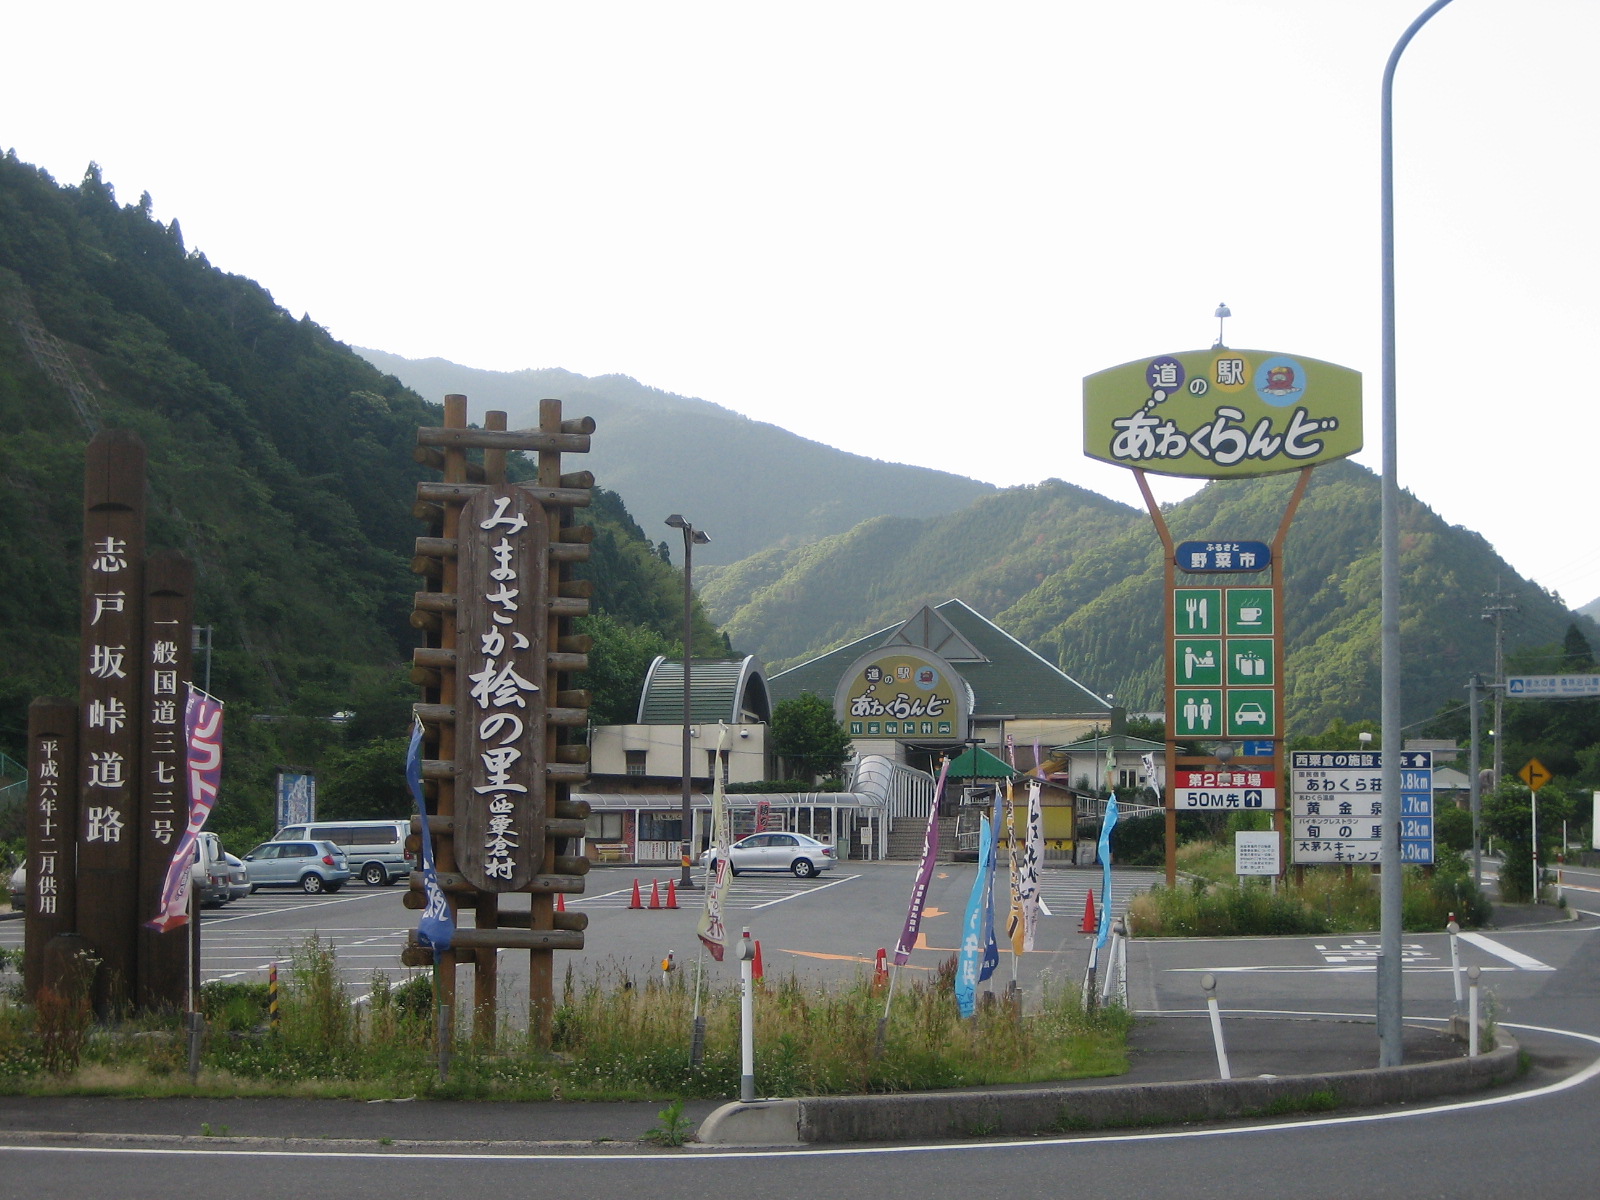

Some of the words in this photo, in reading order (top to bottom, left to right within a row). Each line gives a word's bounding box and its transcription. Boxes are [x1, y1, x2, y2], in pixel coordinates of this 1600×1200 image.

[1152, 359, 1244, 395] 道の駅
[1111, 408, 1336, 464] あわくらんど
[1191, 552, 1256, 568] 野菜市
[87, 535, 128, 844] 志戸坂峠道路
[867, 667, 910, 684] 道の駅
[850, 693, 950, 719] あわくらんど
[151, 619, 178, 846] 一般国道三七三号
[1187, 792, 1240, 807] 50M先
[38, 740, 59, 914] 平成六年十二月供用
